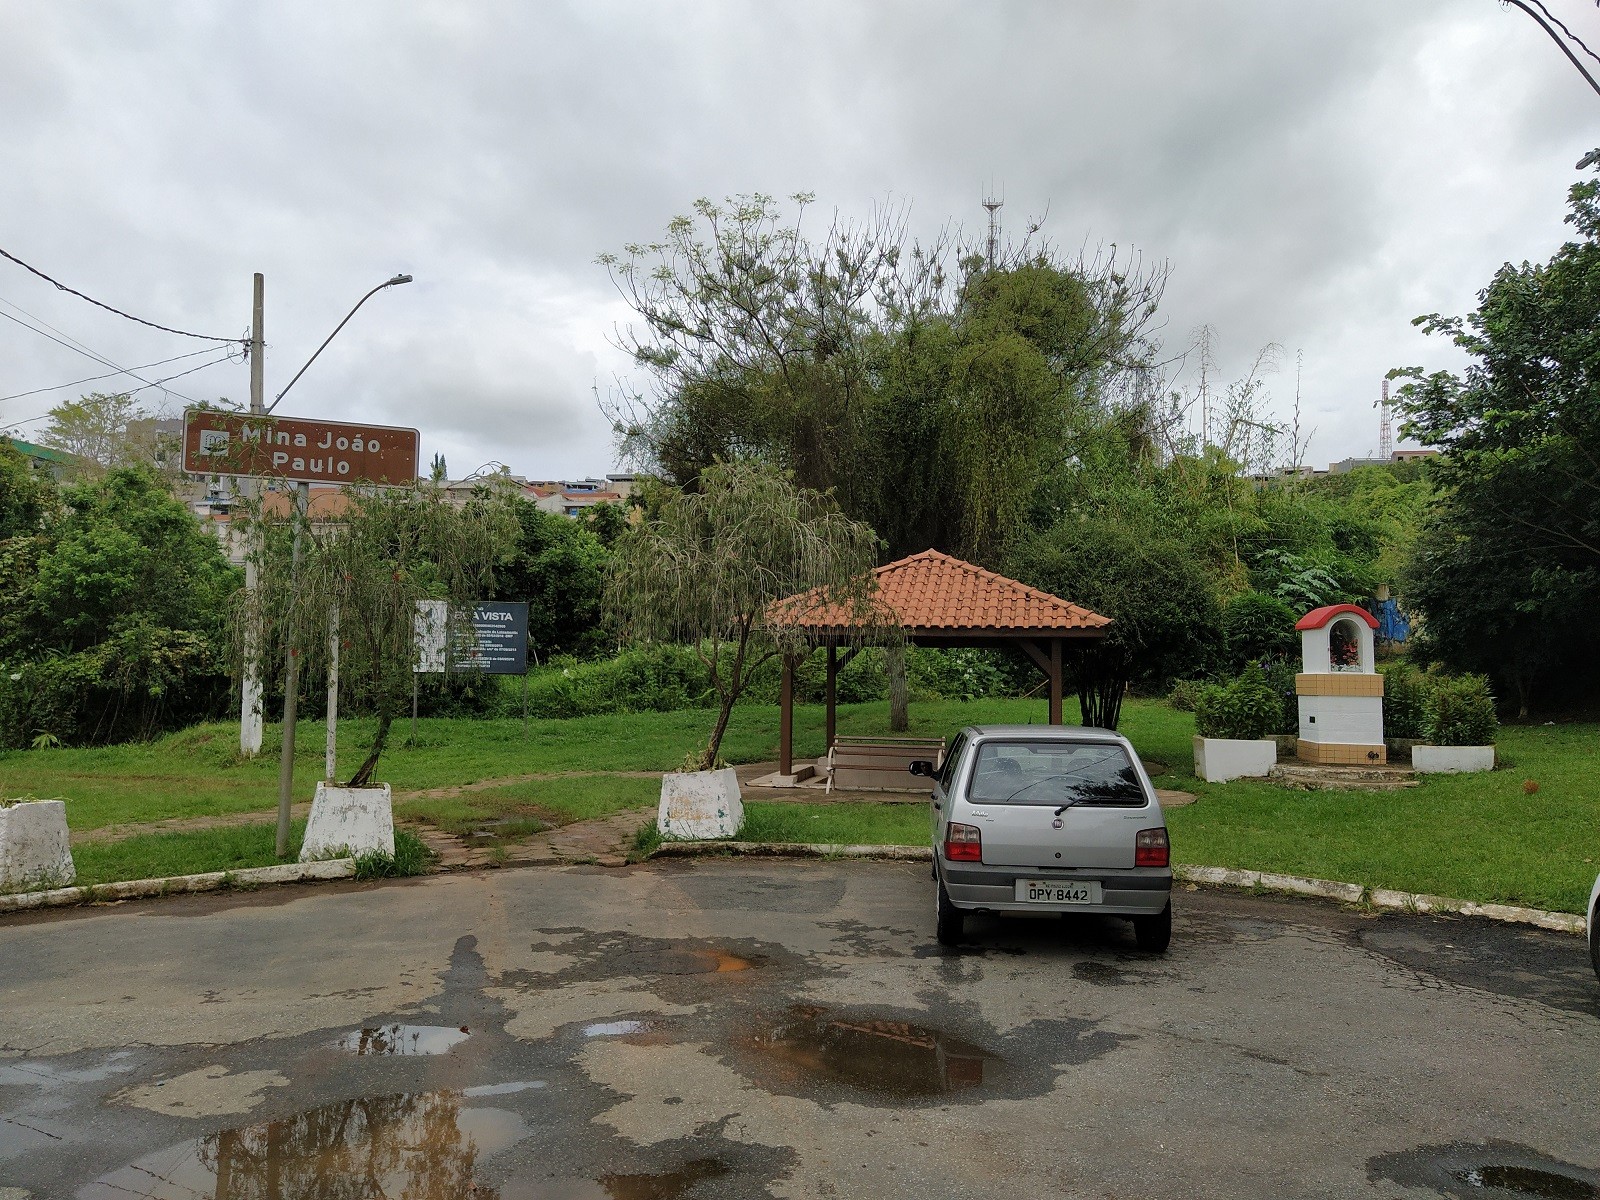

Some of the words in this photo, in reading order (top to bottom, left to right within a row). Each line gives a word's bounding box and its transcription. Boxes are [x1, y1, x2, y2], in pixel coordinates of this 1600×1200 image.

[242, 424, 307, 447] Mina
[272, 451, 350, 475] Paulo
[482, 611, 513, 621] VISTA
